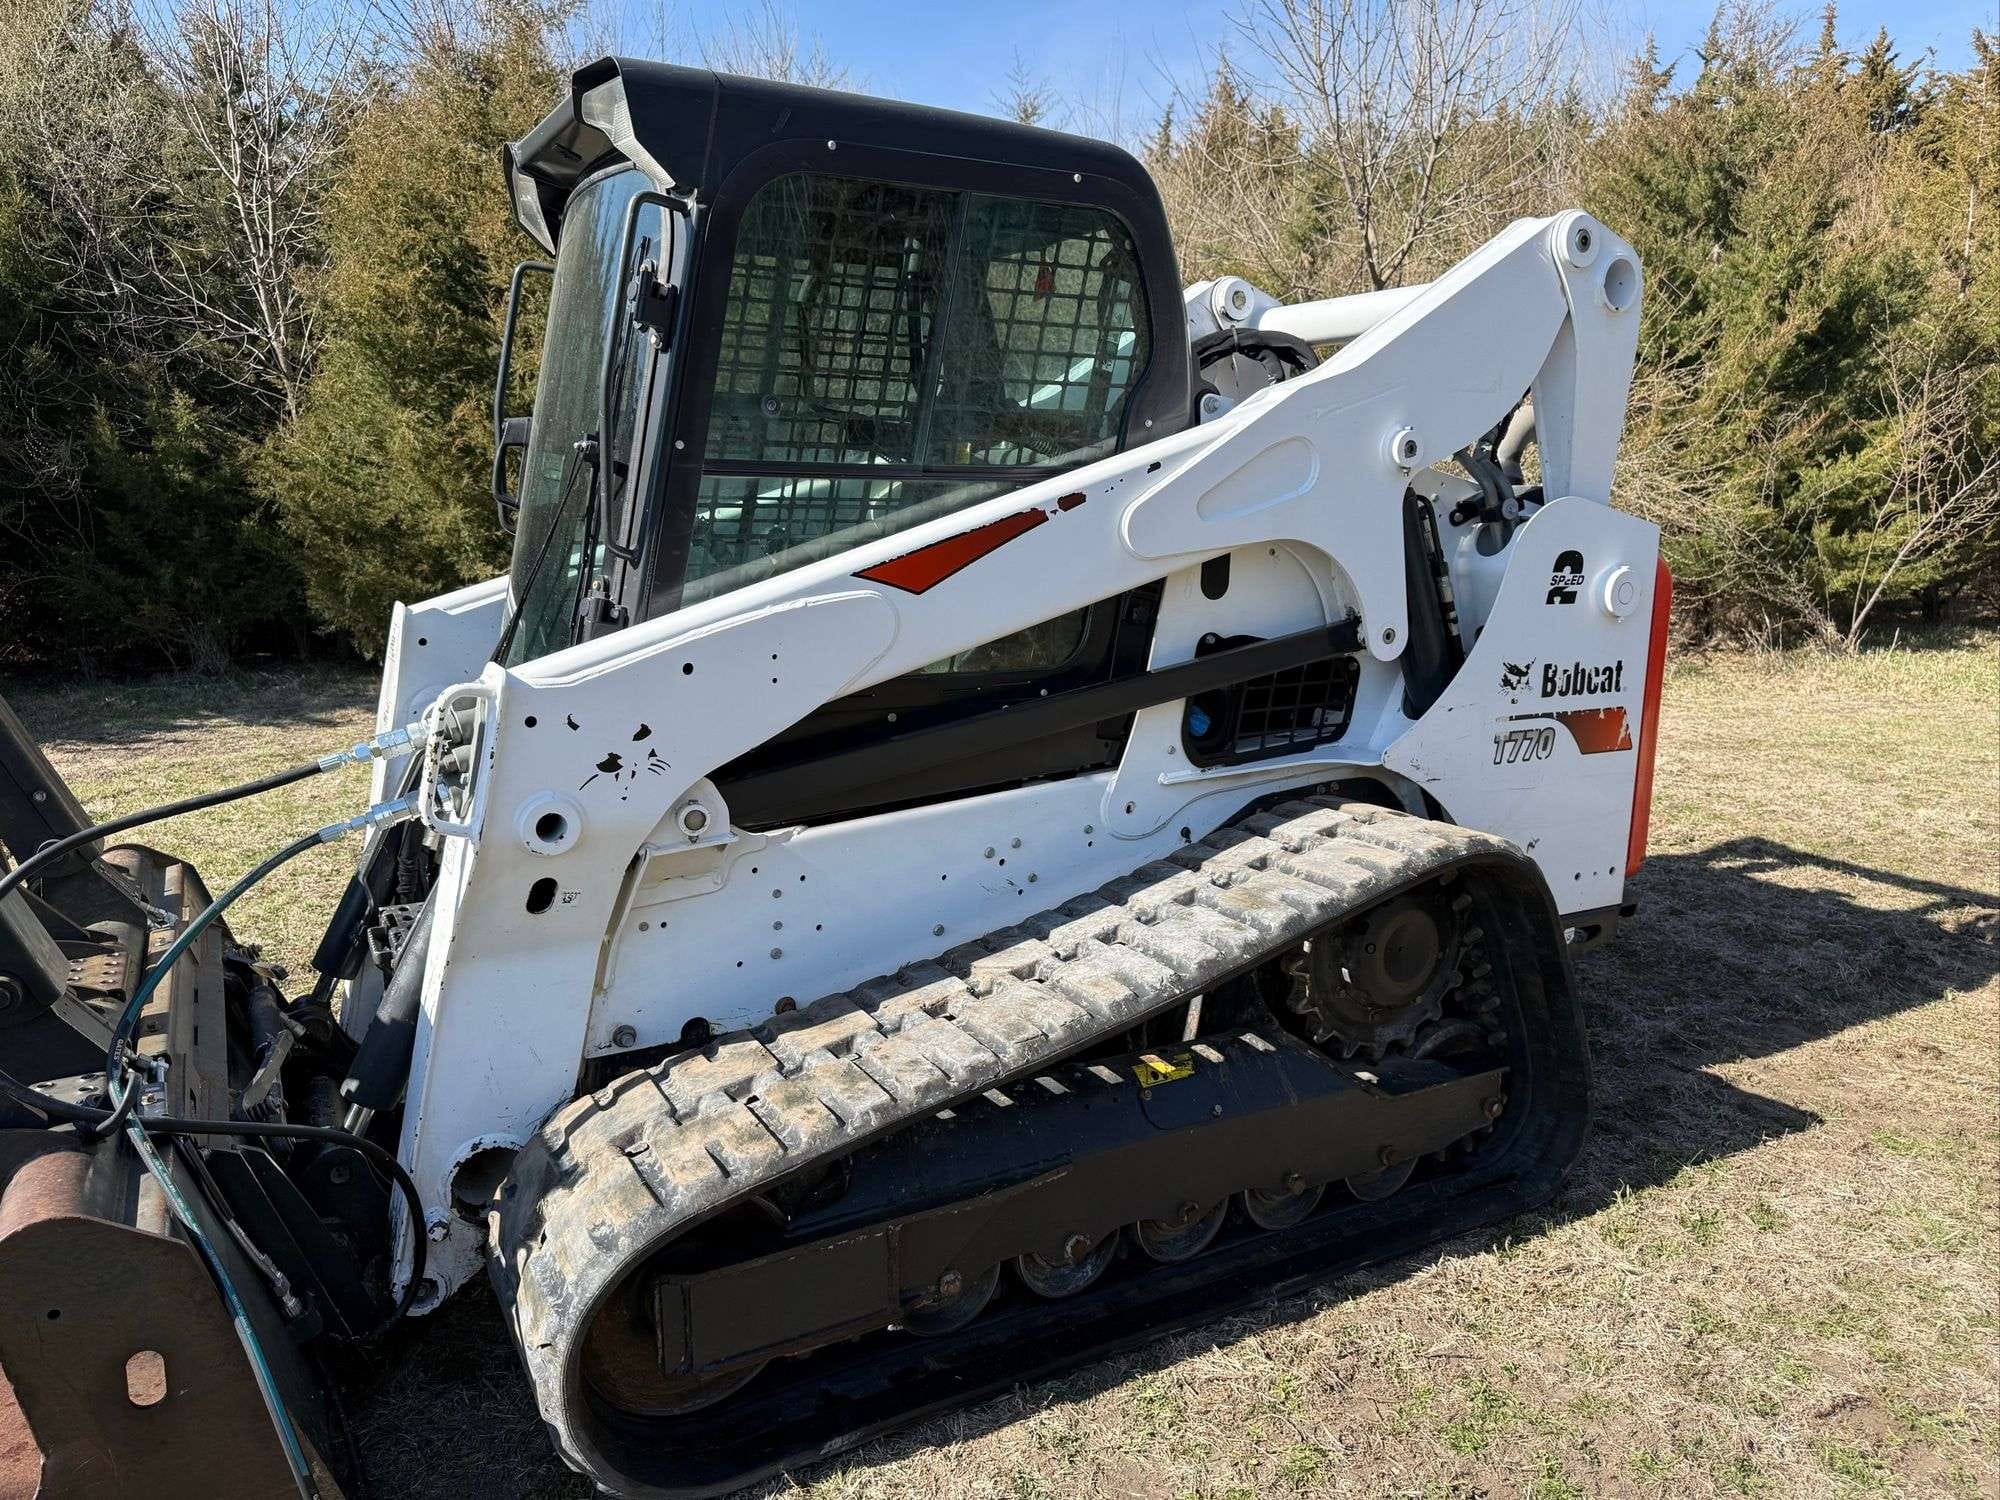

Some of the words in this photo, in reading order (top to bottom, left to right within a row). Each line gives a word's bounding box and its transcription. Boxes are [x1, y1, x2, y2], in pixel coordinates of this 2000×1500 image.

[1545, 550, 1584, 605] 2
[1541, 660, 1623, 698] Bobcat
[1493, 727, 1556, 765] T770
